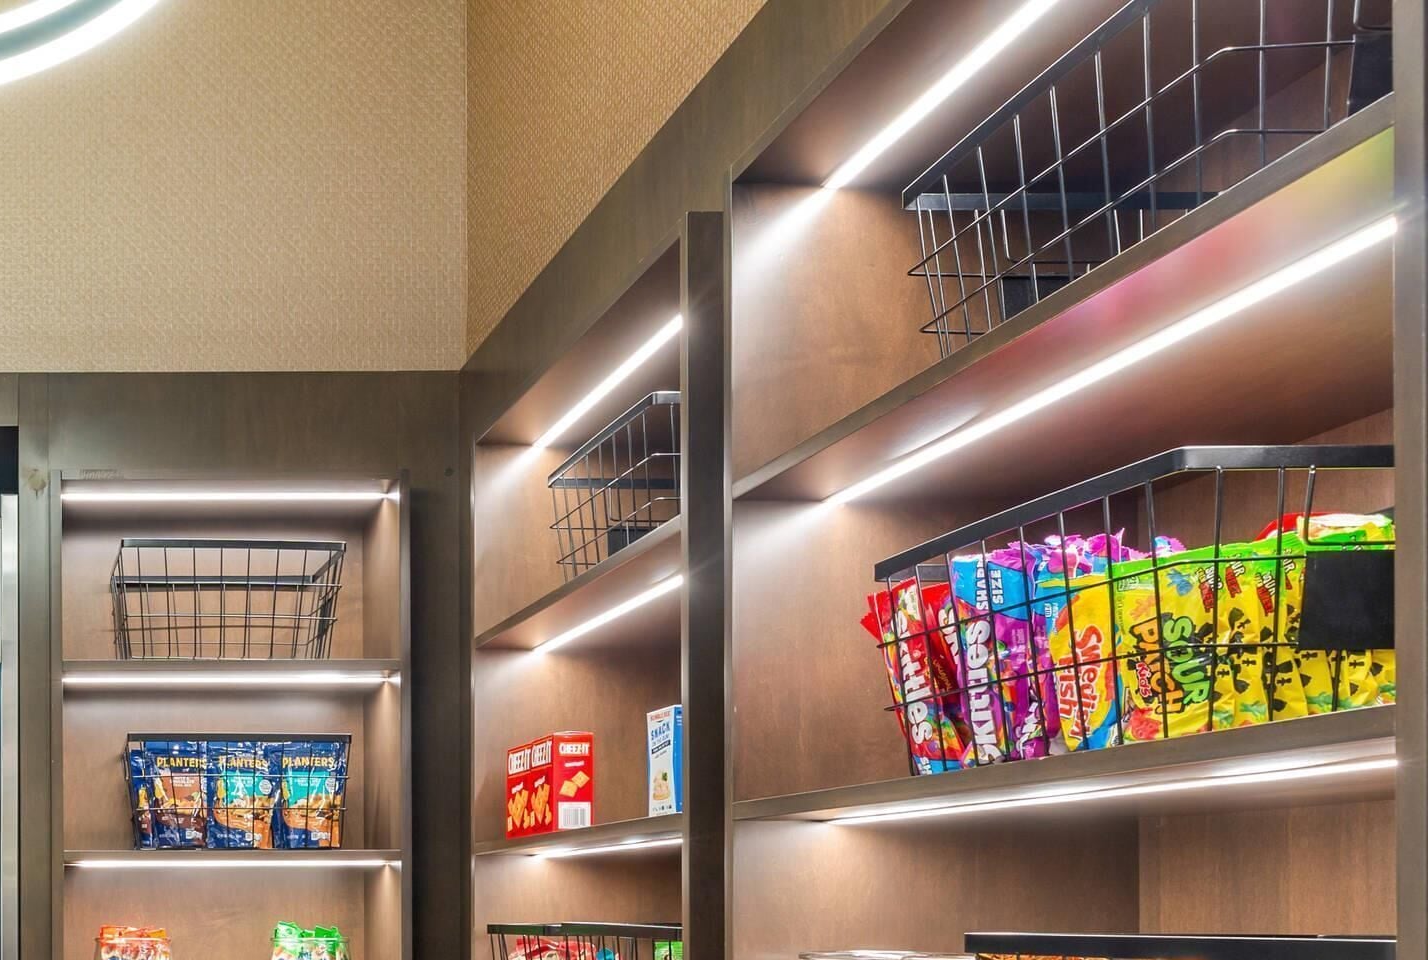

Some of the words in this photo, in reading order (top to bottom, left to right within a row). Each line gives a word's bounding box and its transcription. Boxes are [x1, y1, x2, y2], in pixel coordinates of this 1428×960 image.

[990, 569, 1004, 606] SIZE
[1068, 624, 1104, 742] Swedish
[1128, 616, 1187, 716] PATCH
[1162, 614, 1215, 706] SOUR
[282, 756, 334, 769] PLANTERS
